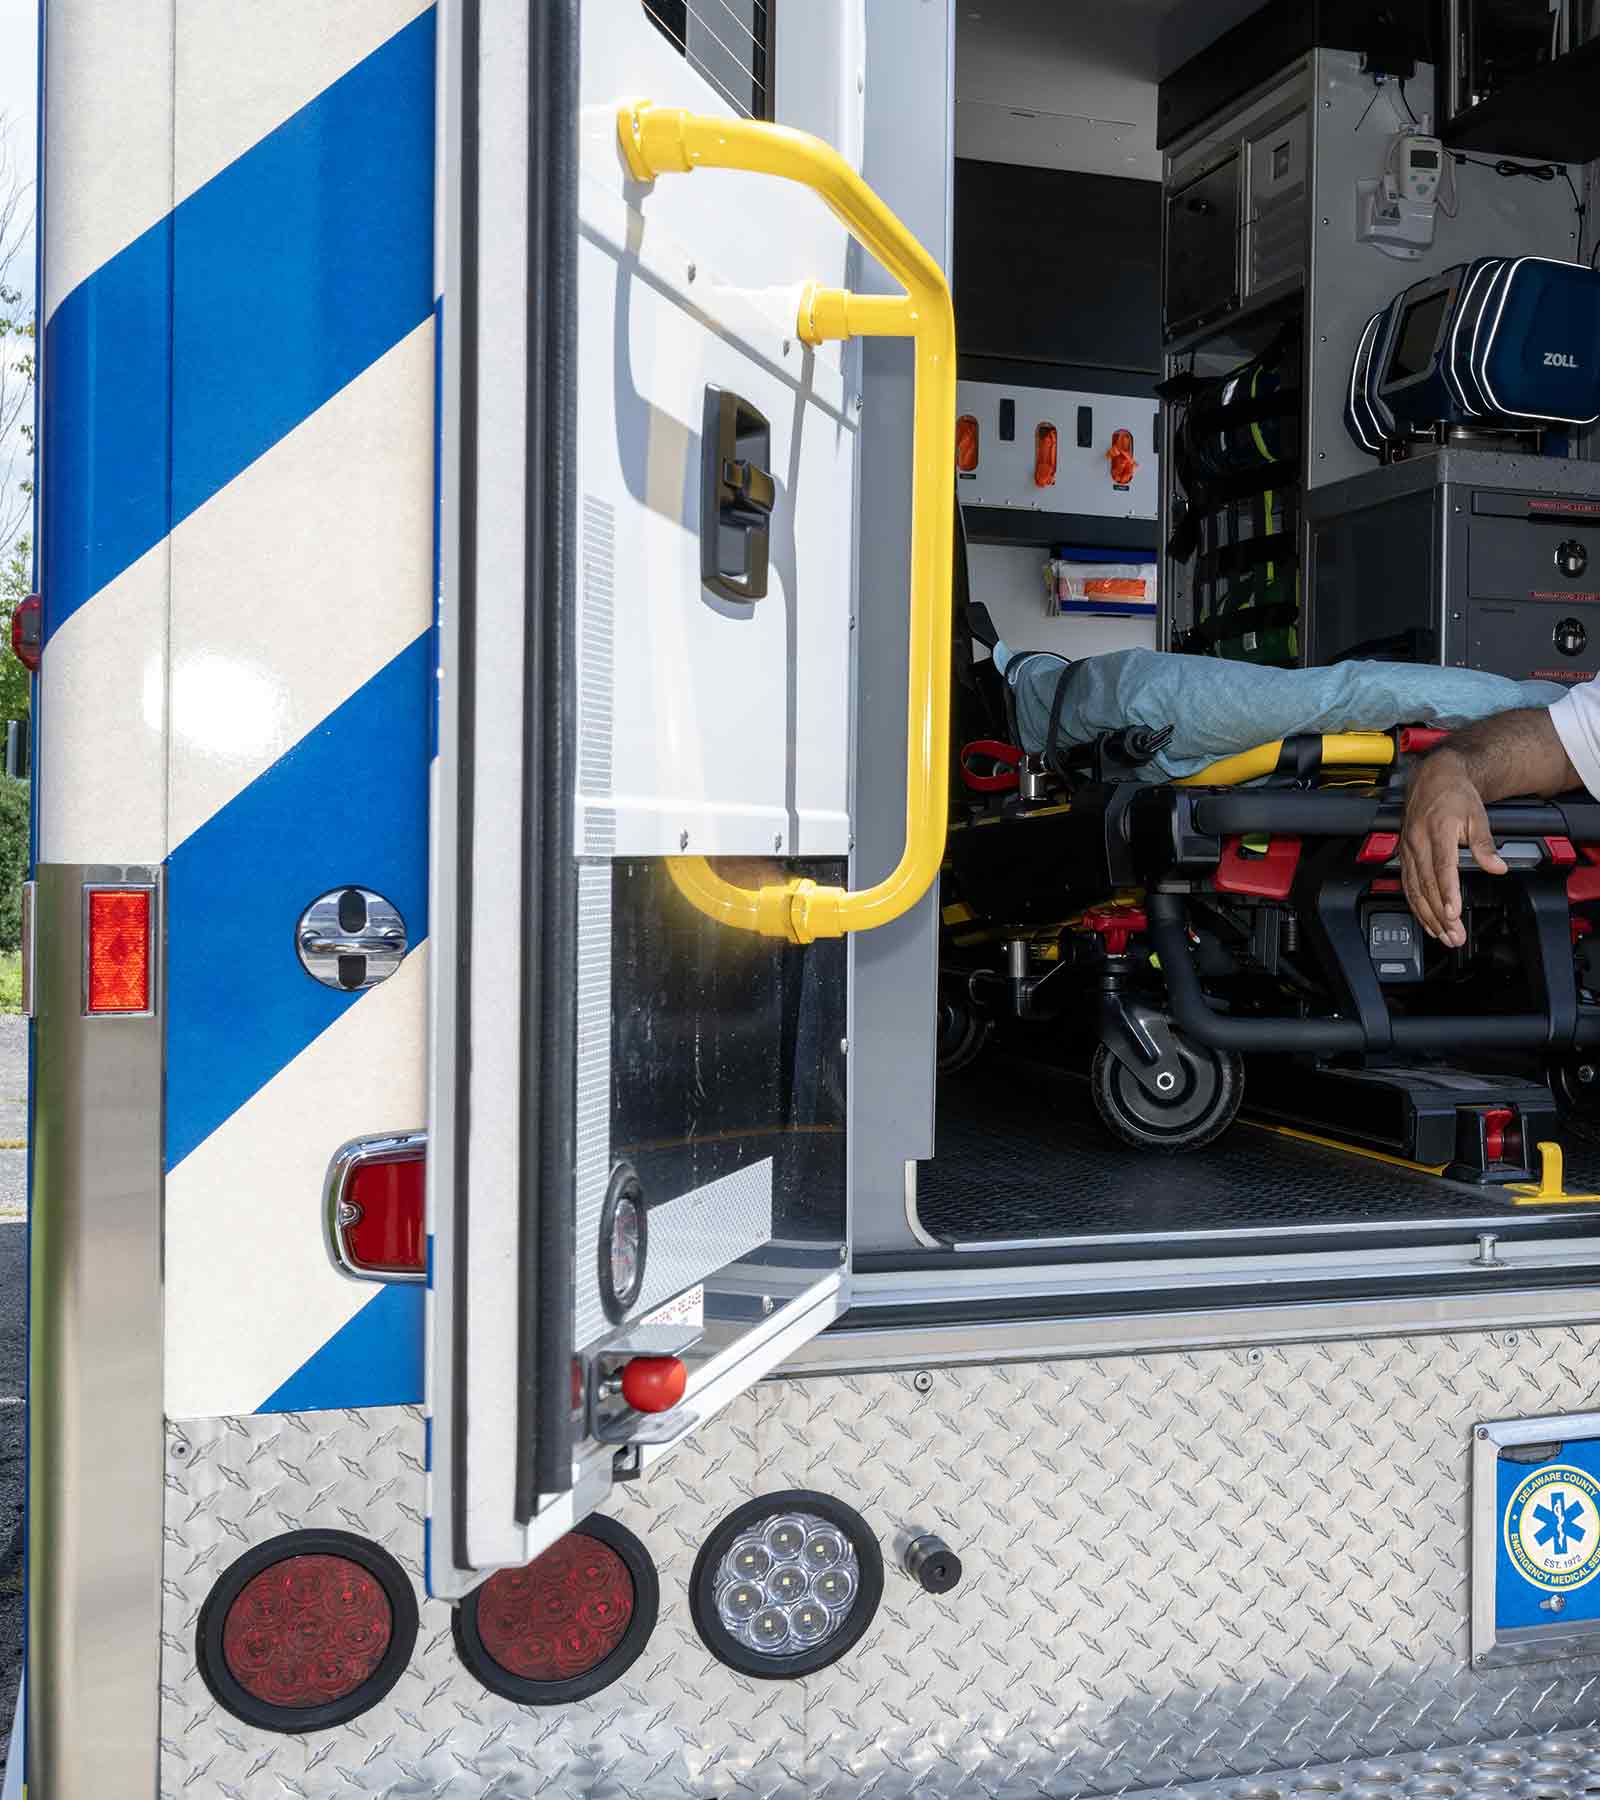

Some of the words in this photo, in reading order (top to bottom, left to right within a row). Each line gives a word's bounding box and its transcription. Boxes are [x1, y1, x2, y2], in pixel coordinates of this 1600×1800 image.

[1543, 352, 1578, 368] ZOLL
[1518, 1472, 1562, 1504] DELAWARE
[1563, 1472, 1598, 1497] COUNTY
[1511, 1533, 1551, 1583] EMERGENCY
[1551, 1566, 1591, 1584] MEDICAL
[1543, 1558, 1562, 1569] EST.
[1563, 1554, 1583, 1569] 1972
